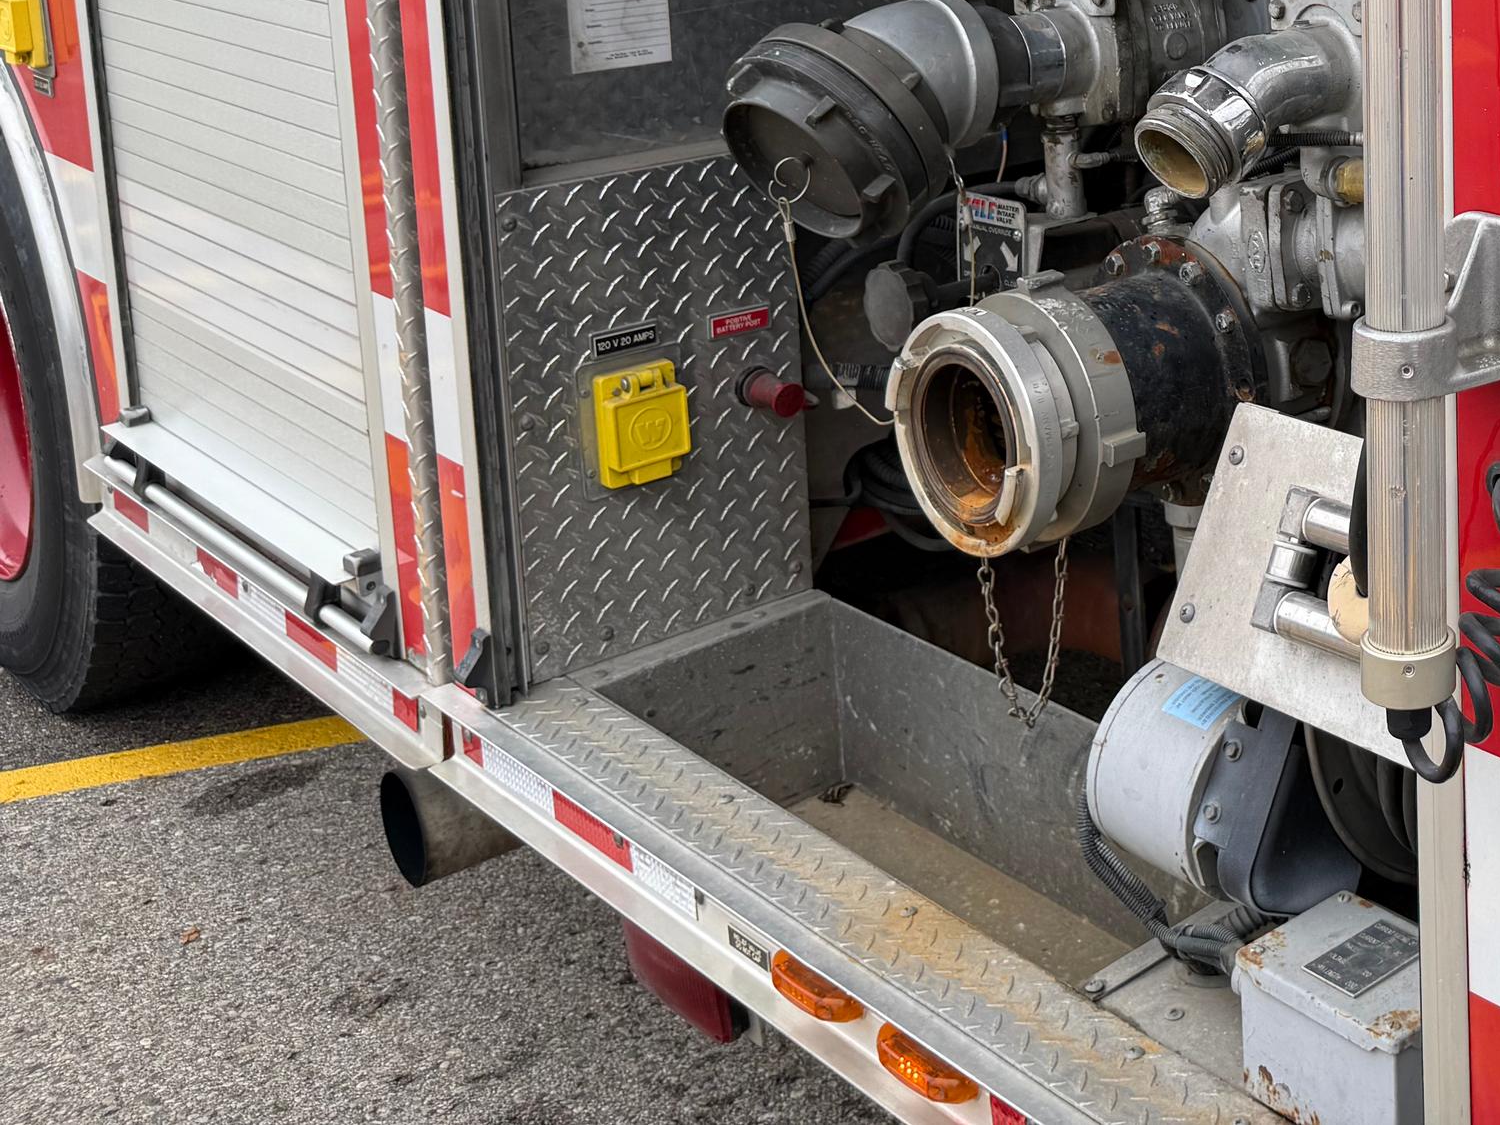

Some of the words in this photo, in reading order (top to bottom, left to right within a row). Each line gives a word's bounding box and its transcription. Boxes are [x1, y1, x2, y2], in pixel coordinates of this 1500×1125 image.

[997, 202, 1020, 213] MASTER
[996, 209, 1016, 219] INTAKE
[996, 216, 1013, 225] VALVE
[716, 322, 745, 334] BATTERY
[745, 318, 761, 328] POST
[597, 338, 611, 351] 120
[612, 338, 619, 348] V
[620, 336, 632, 347] 20
[633, 330, 655, 344] AMPS
